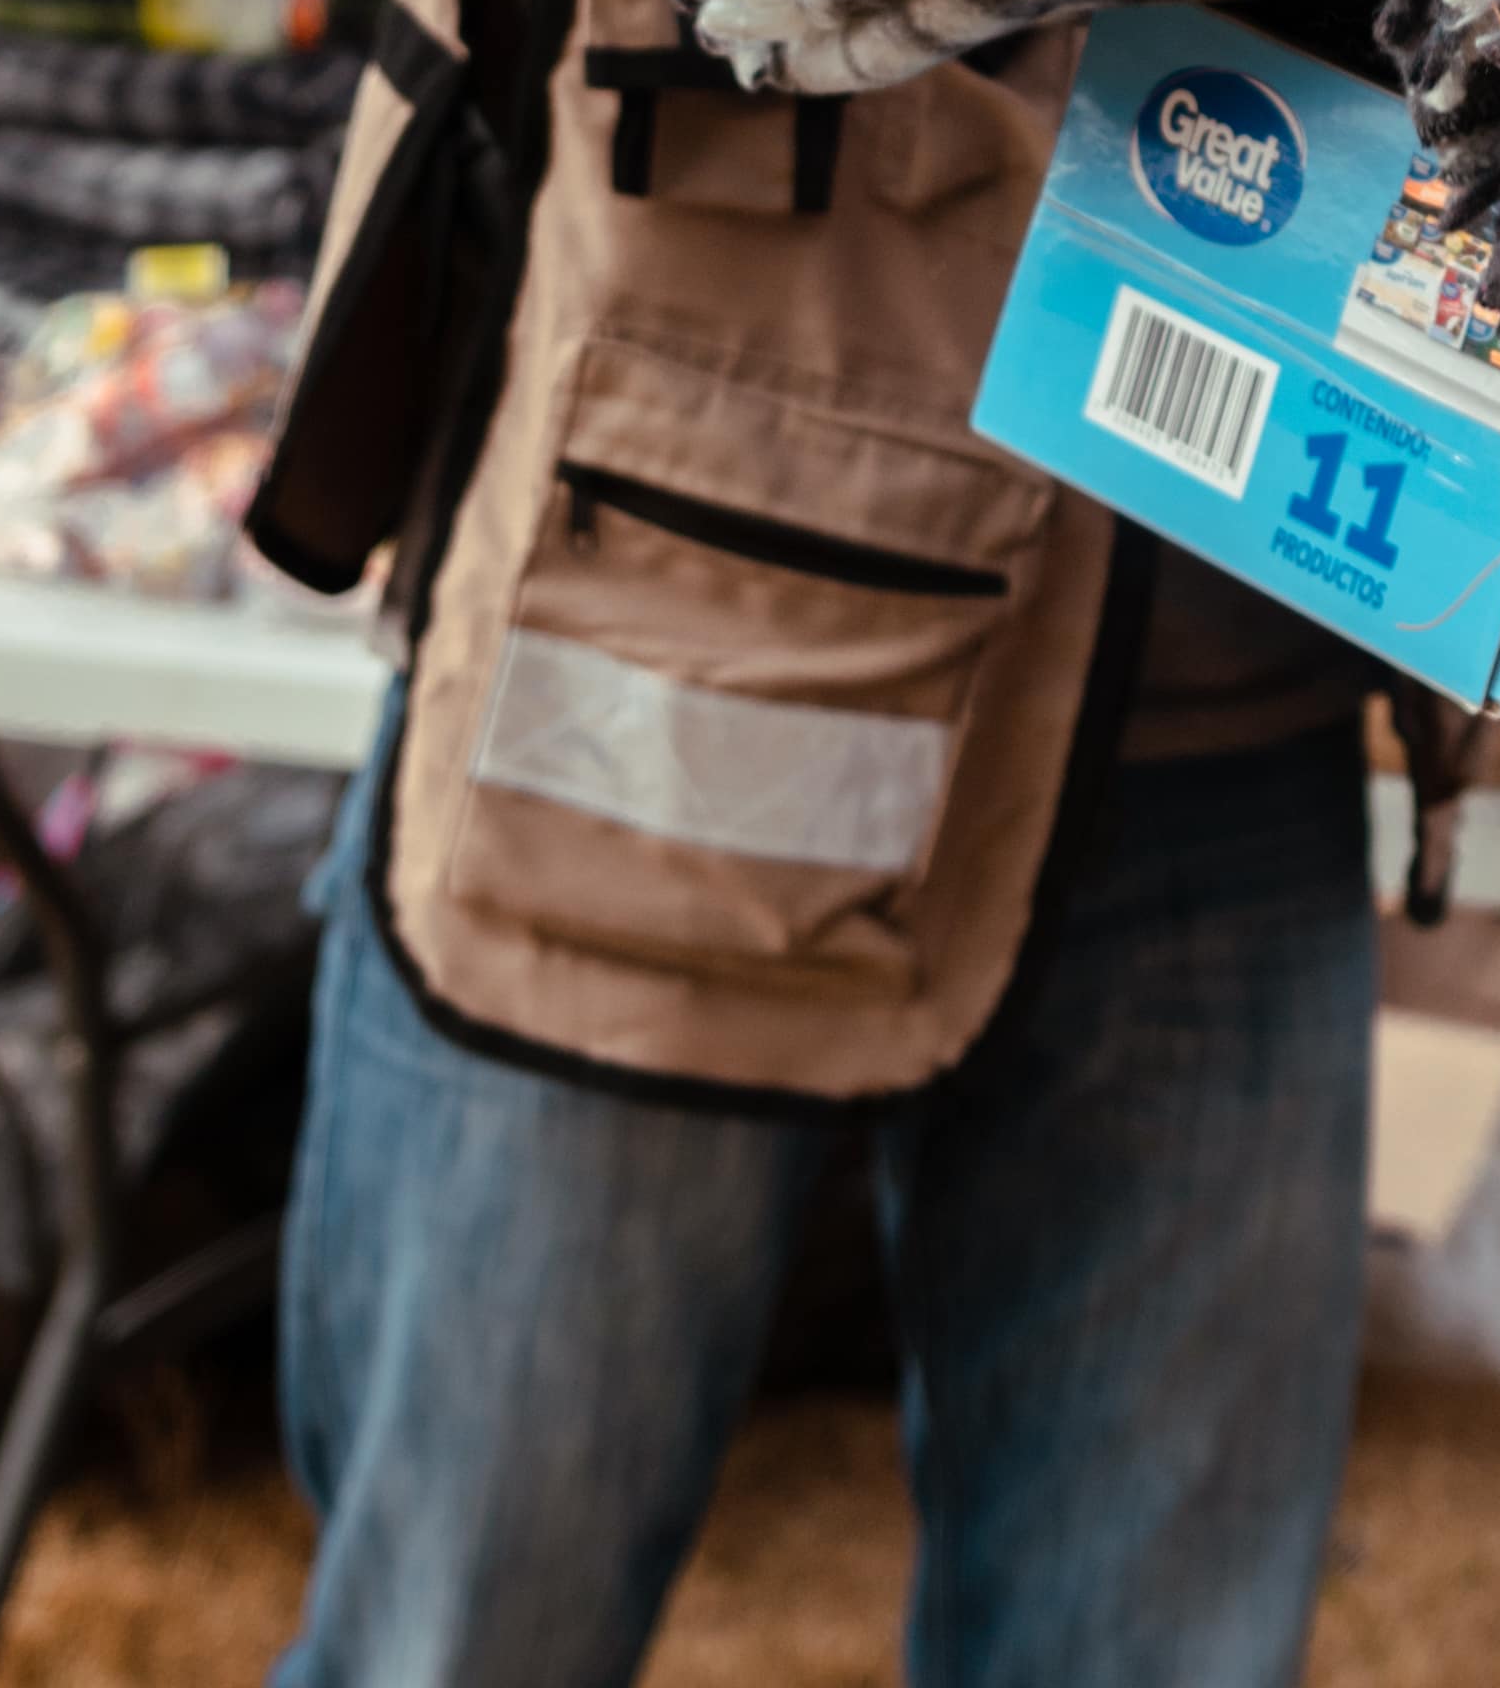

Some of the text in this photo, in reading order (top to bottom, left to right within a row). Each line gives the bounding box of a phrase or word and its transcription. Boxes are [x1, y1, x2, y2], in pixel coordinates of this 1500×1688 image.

[1159, 88, 1280, 190] Great
[1176, 148, 1264, 223] Value
[1287, 433, 1406, 571] 11
[1271, 526, 1387, 610] PRODUCTOS
